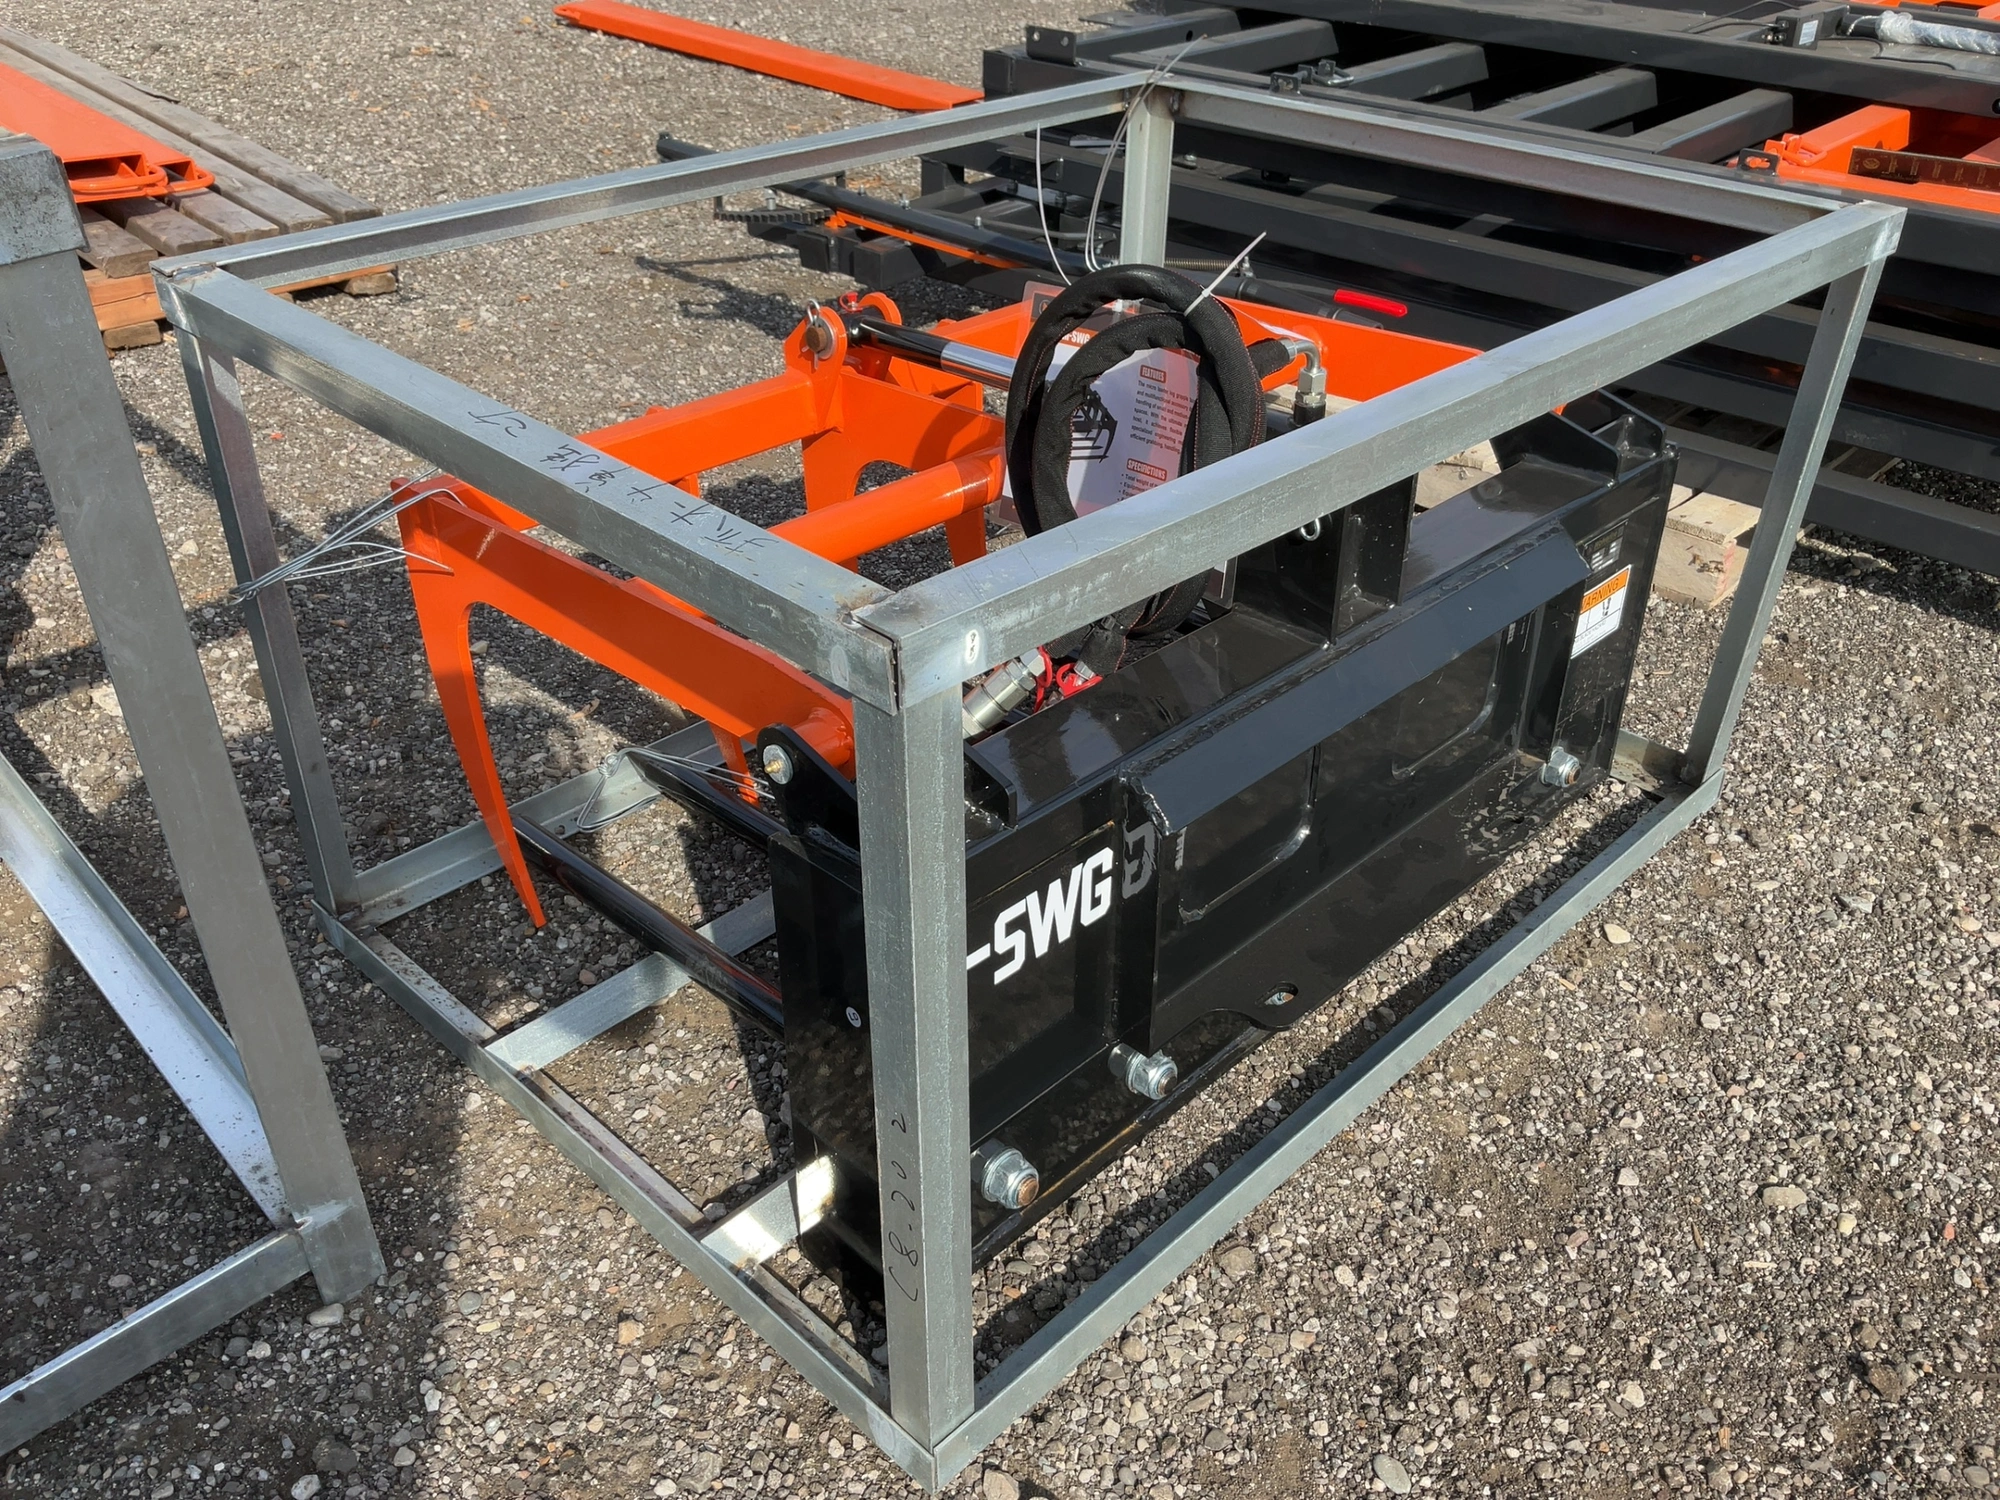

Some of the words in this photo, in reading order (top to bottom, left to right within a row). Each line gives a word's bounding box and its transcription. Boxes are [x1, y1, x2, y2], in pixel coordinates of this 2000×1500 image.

[1142, 366, 1165, 382] FEATURES
[1130, 433, 1146, 442] efficient
[1582, 578, 1620, 608] ARNING
